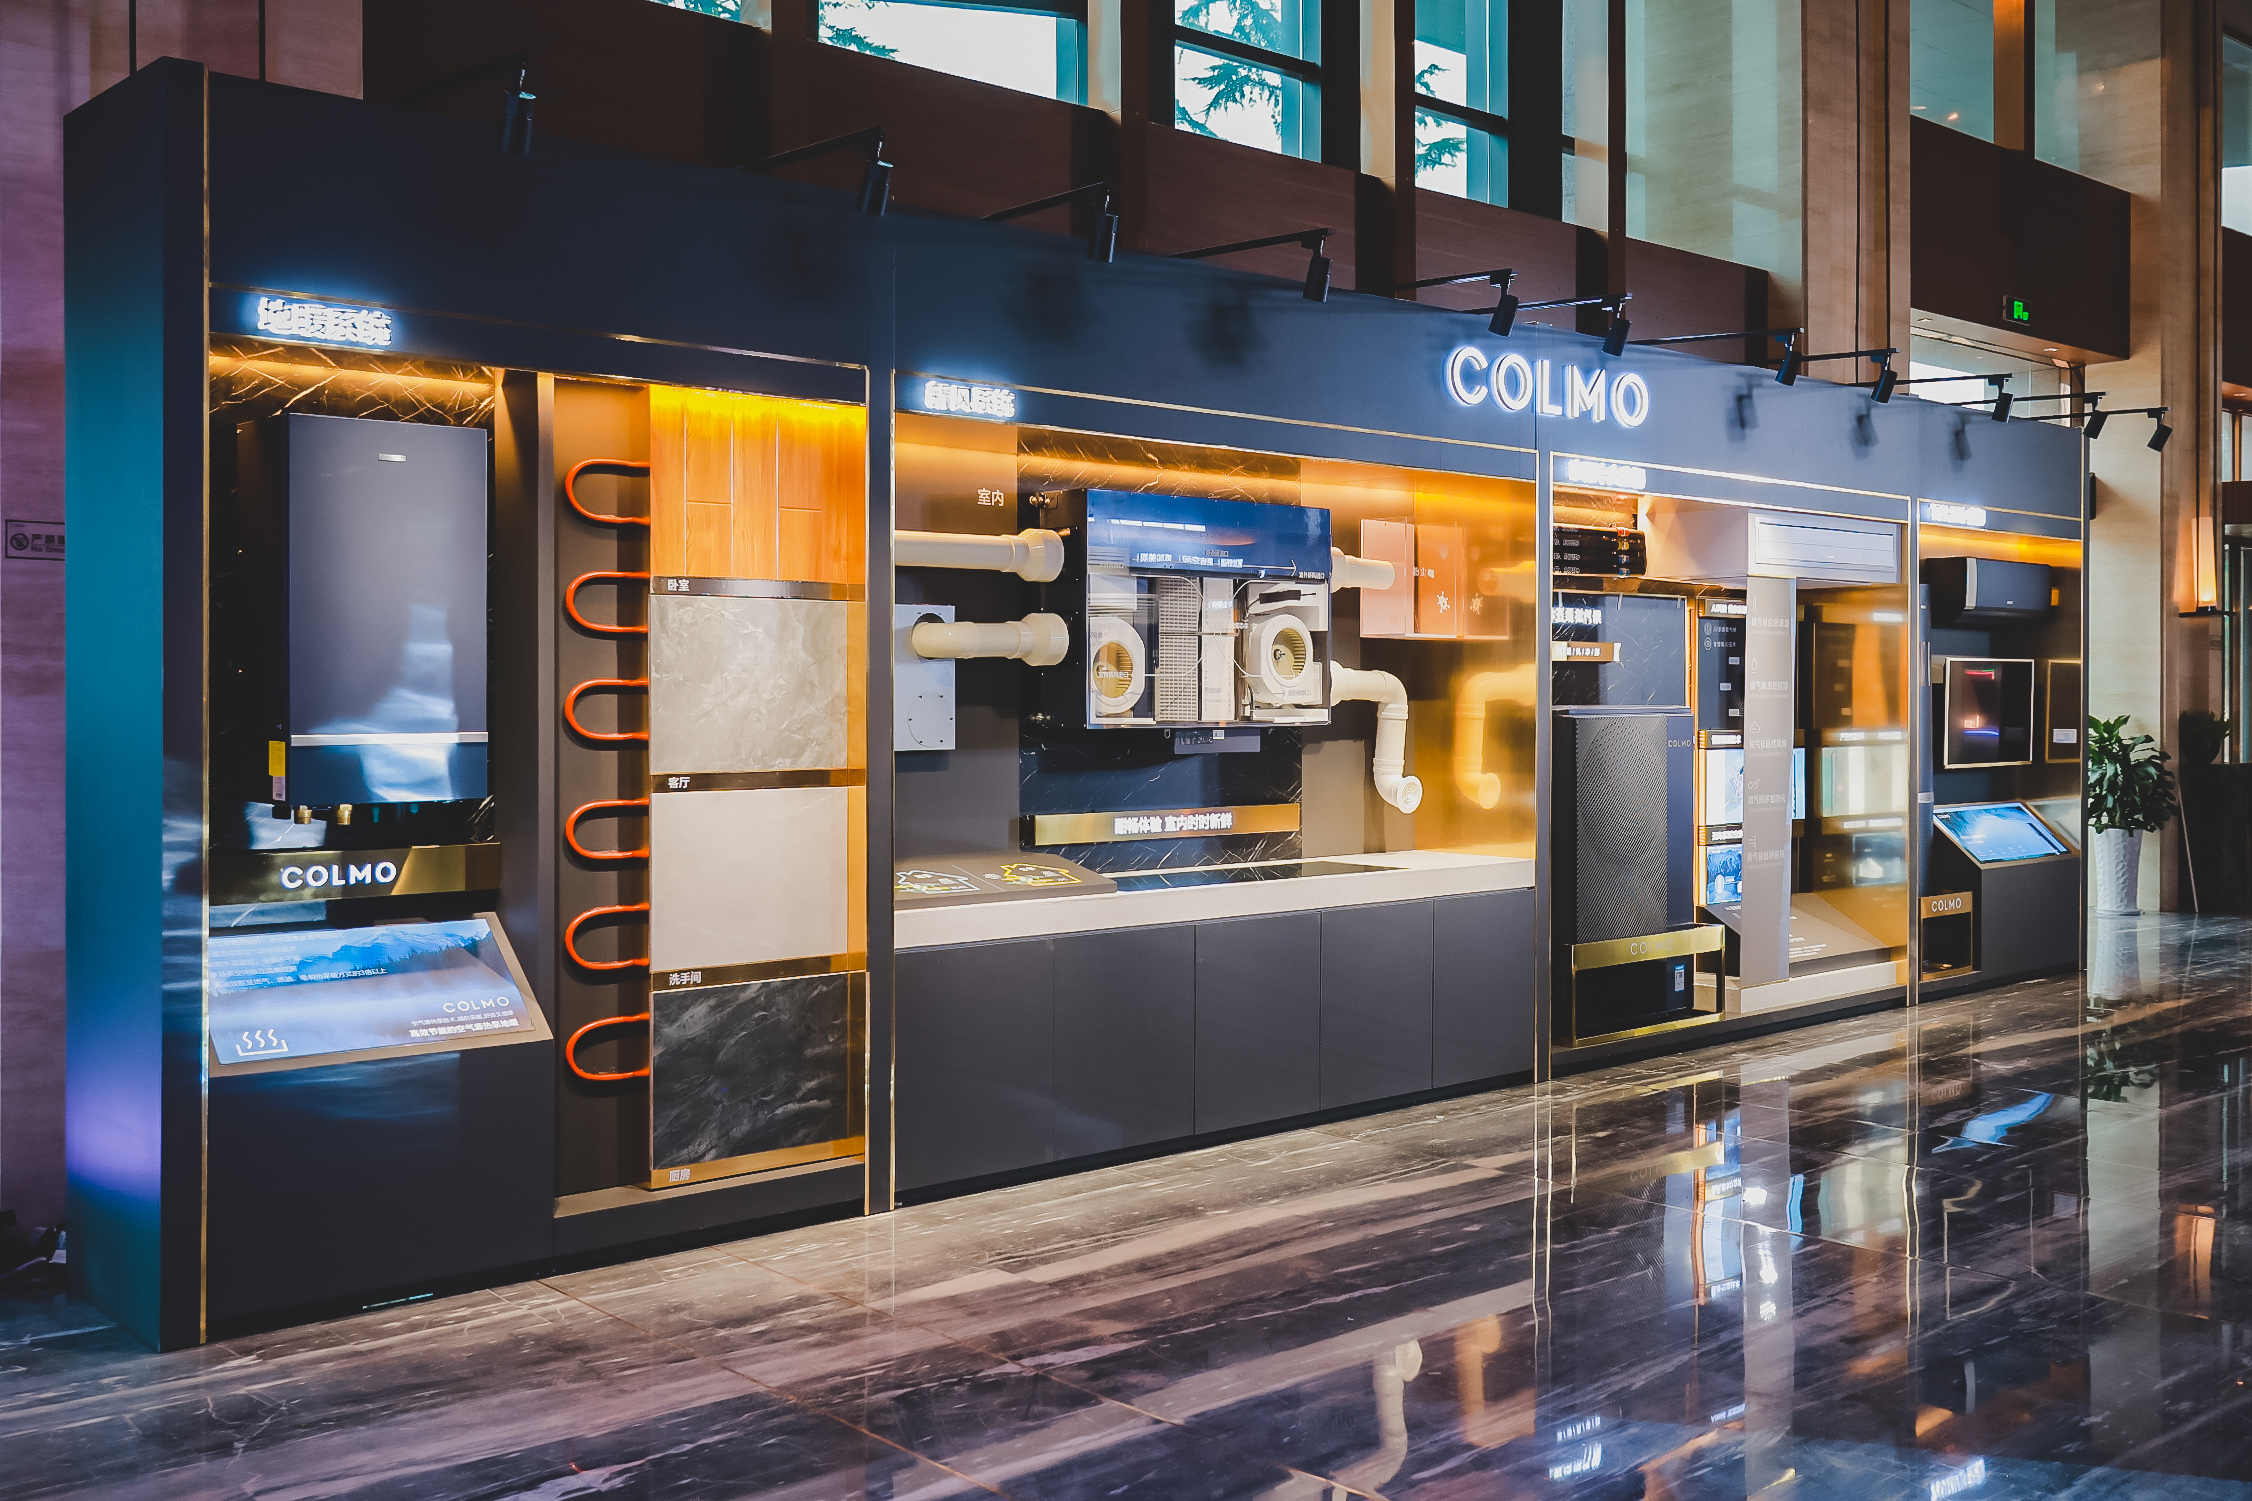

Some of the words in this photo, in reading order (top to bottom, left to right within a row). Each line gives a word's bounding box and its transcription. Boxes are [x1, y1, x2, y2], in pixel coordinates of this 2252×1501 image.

[258, 297, 392, 346] 地暖系统
[1446, 346, 1650, 428] COLMO
[924, 381, 1016, 418] 新风系统
[977, 488, 1004, 507] 室内
[667, 578, 690, 592] 卧室
[1667, 739, 1692, 747] COLMO
[668, 776, 690, 789] 客厅
[280, 861, 397, 889] COLMO
[1930, 897, 1962, 912] COLMO
[1630, 938, 1674, 956] COLMO
[668, 971, 702, 985] 洗手间
[443, 996, 510, 1013] COLMO
[669, 1168, 691, 1182] 厨房
